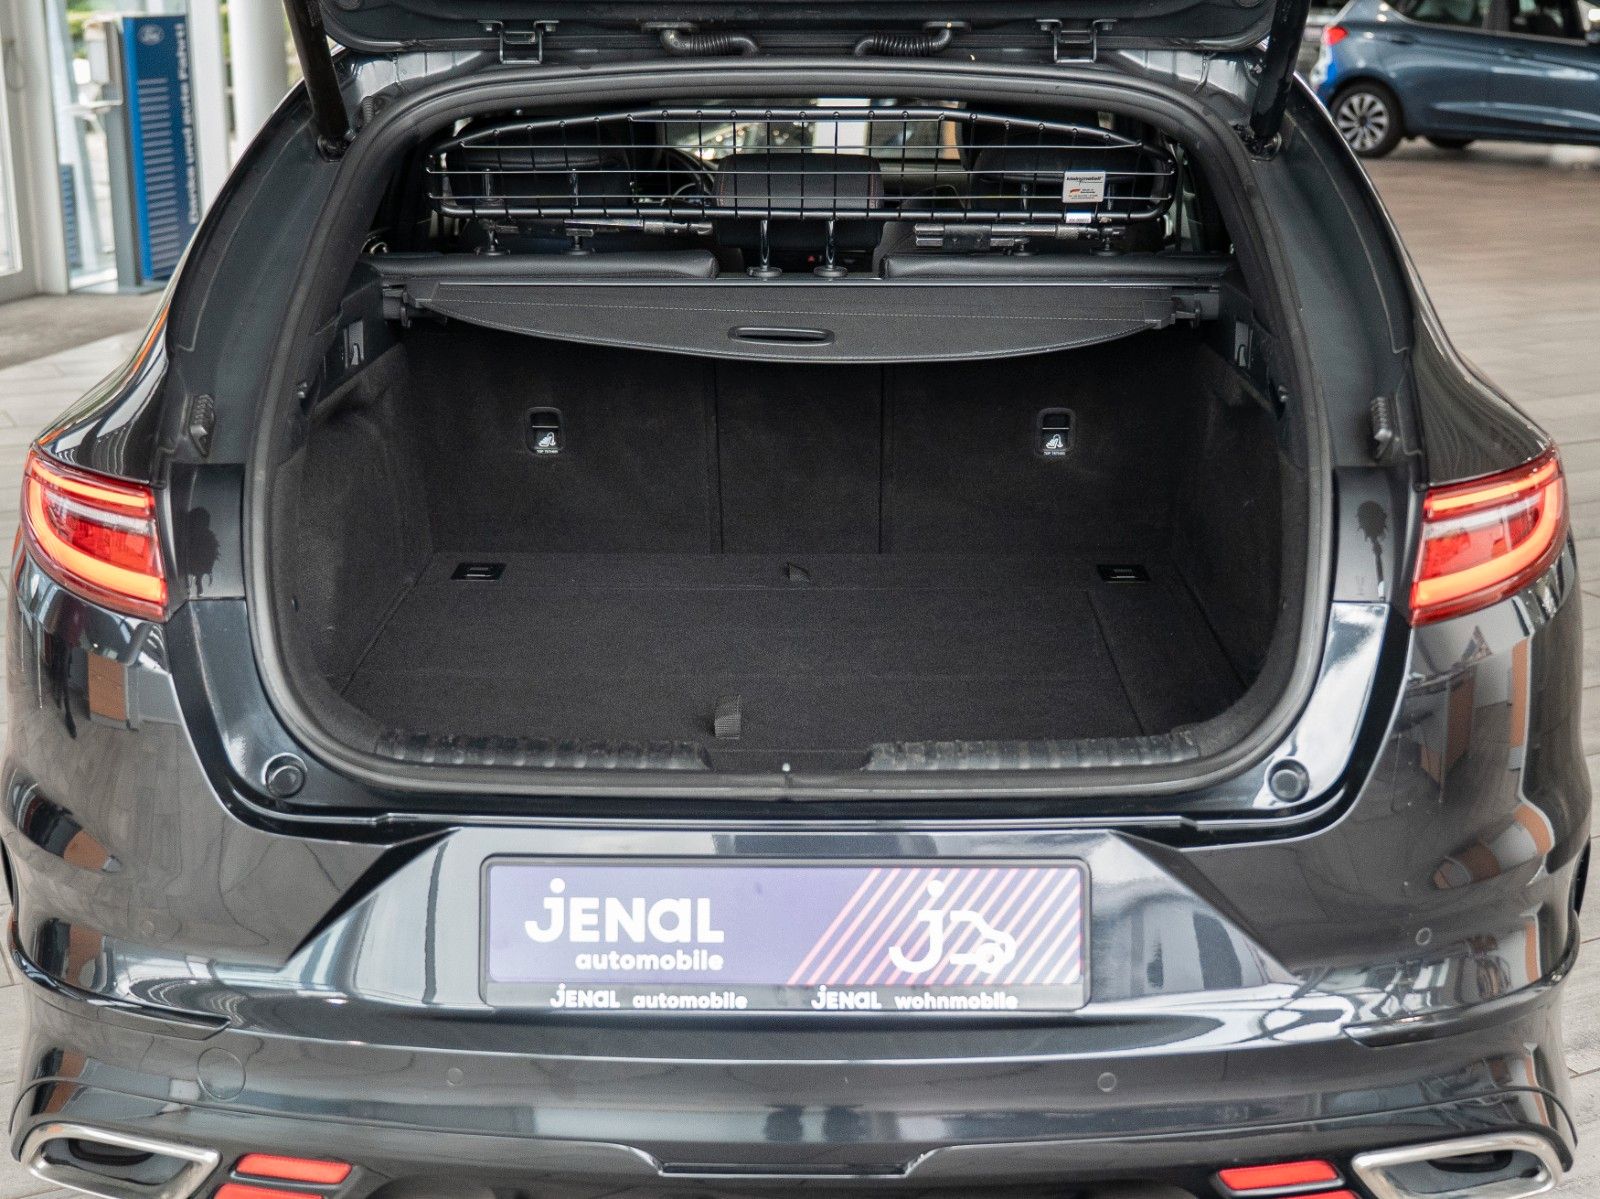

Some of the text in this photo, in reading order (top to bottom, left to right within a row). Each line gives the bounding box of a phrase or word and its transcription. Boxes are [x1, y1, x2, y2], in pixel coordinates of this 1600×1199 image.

[175, 23, 189, 80] Fahrt!
[179, 82, 192, 125] gute
[183, 127, 195, 164] und
[575, 951, 724, 970] automobile
[632, 993, 748, 1010] automobile
[895, 995, 1019, 1010] wohnmobile
